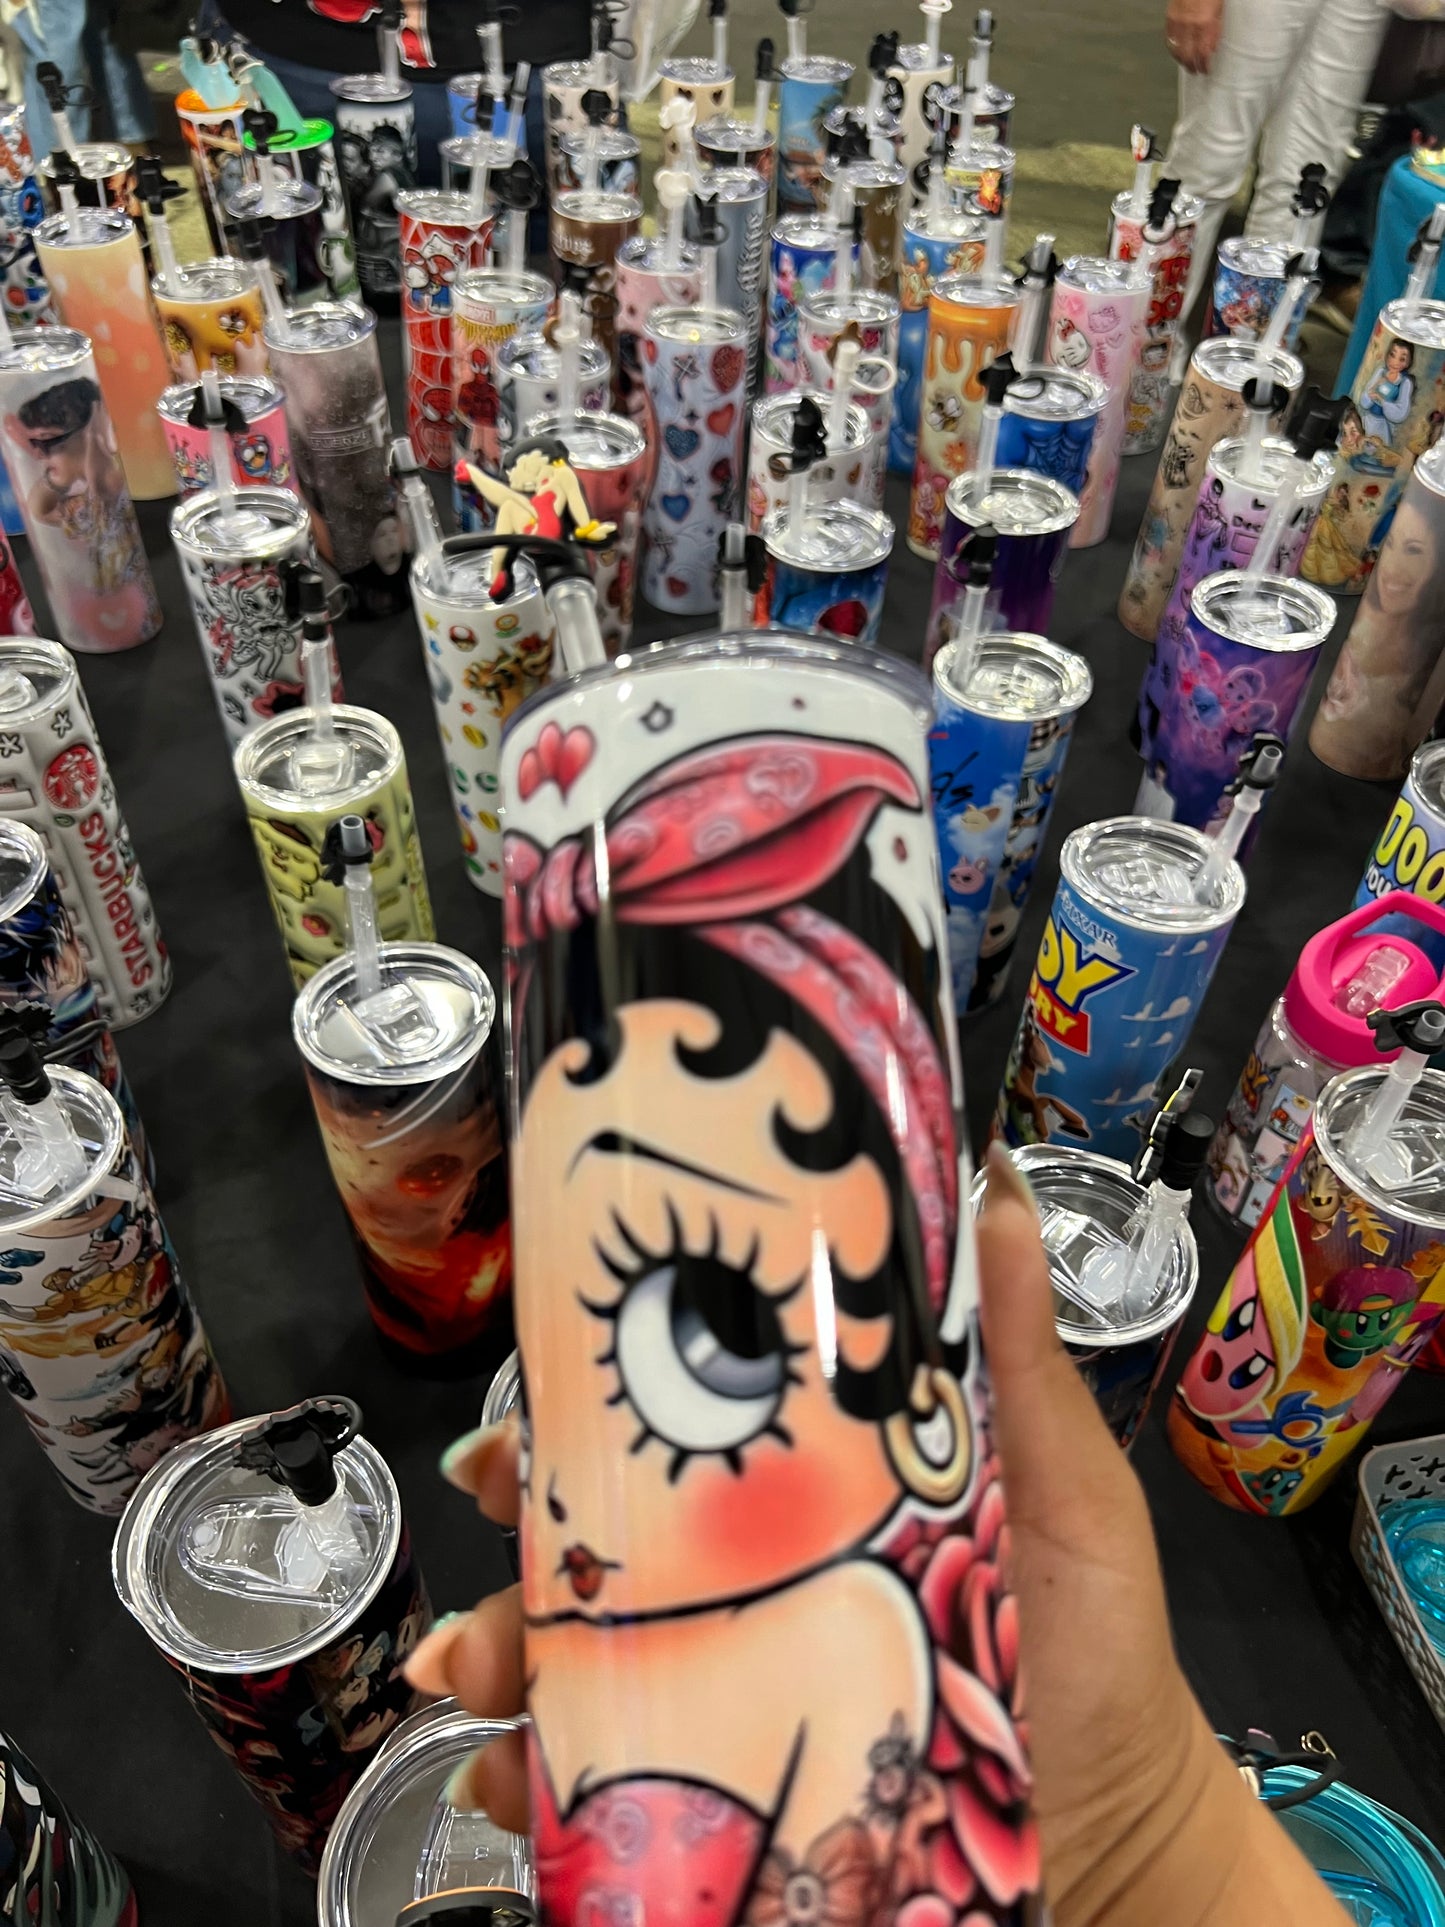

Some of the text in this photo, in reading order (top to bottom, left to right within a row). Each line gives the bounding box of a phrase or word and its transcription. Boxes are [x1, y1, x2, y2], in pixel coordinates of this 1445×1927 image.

[79, 811, 154, 987] STARBUCKS
[1060, 897, 1117, 949] PIXAR
[1036, 914, 1123, 1009] OY
